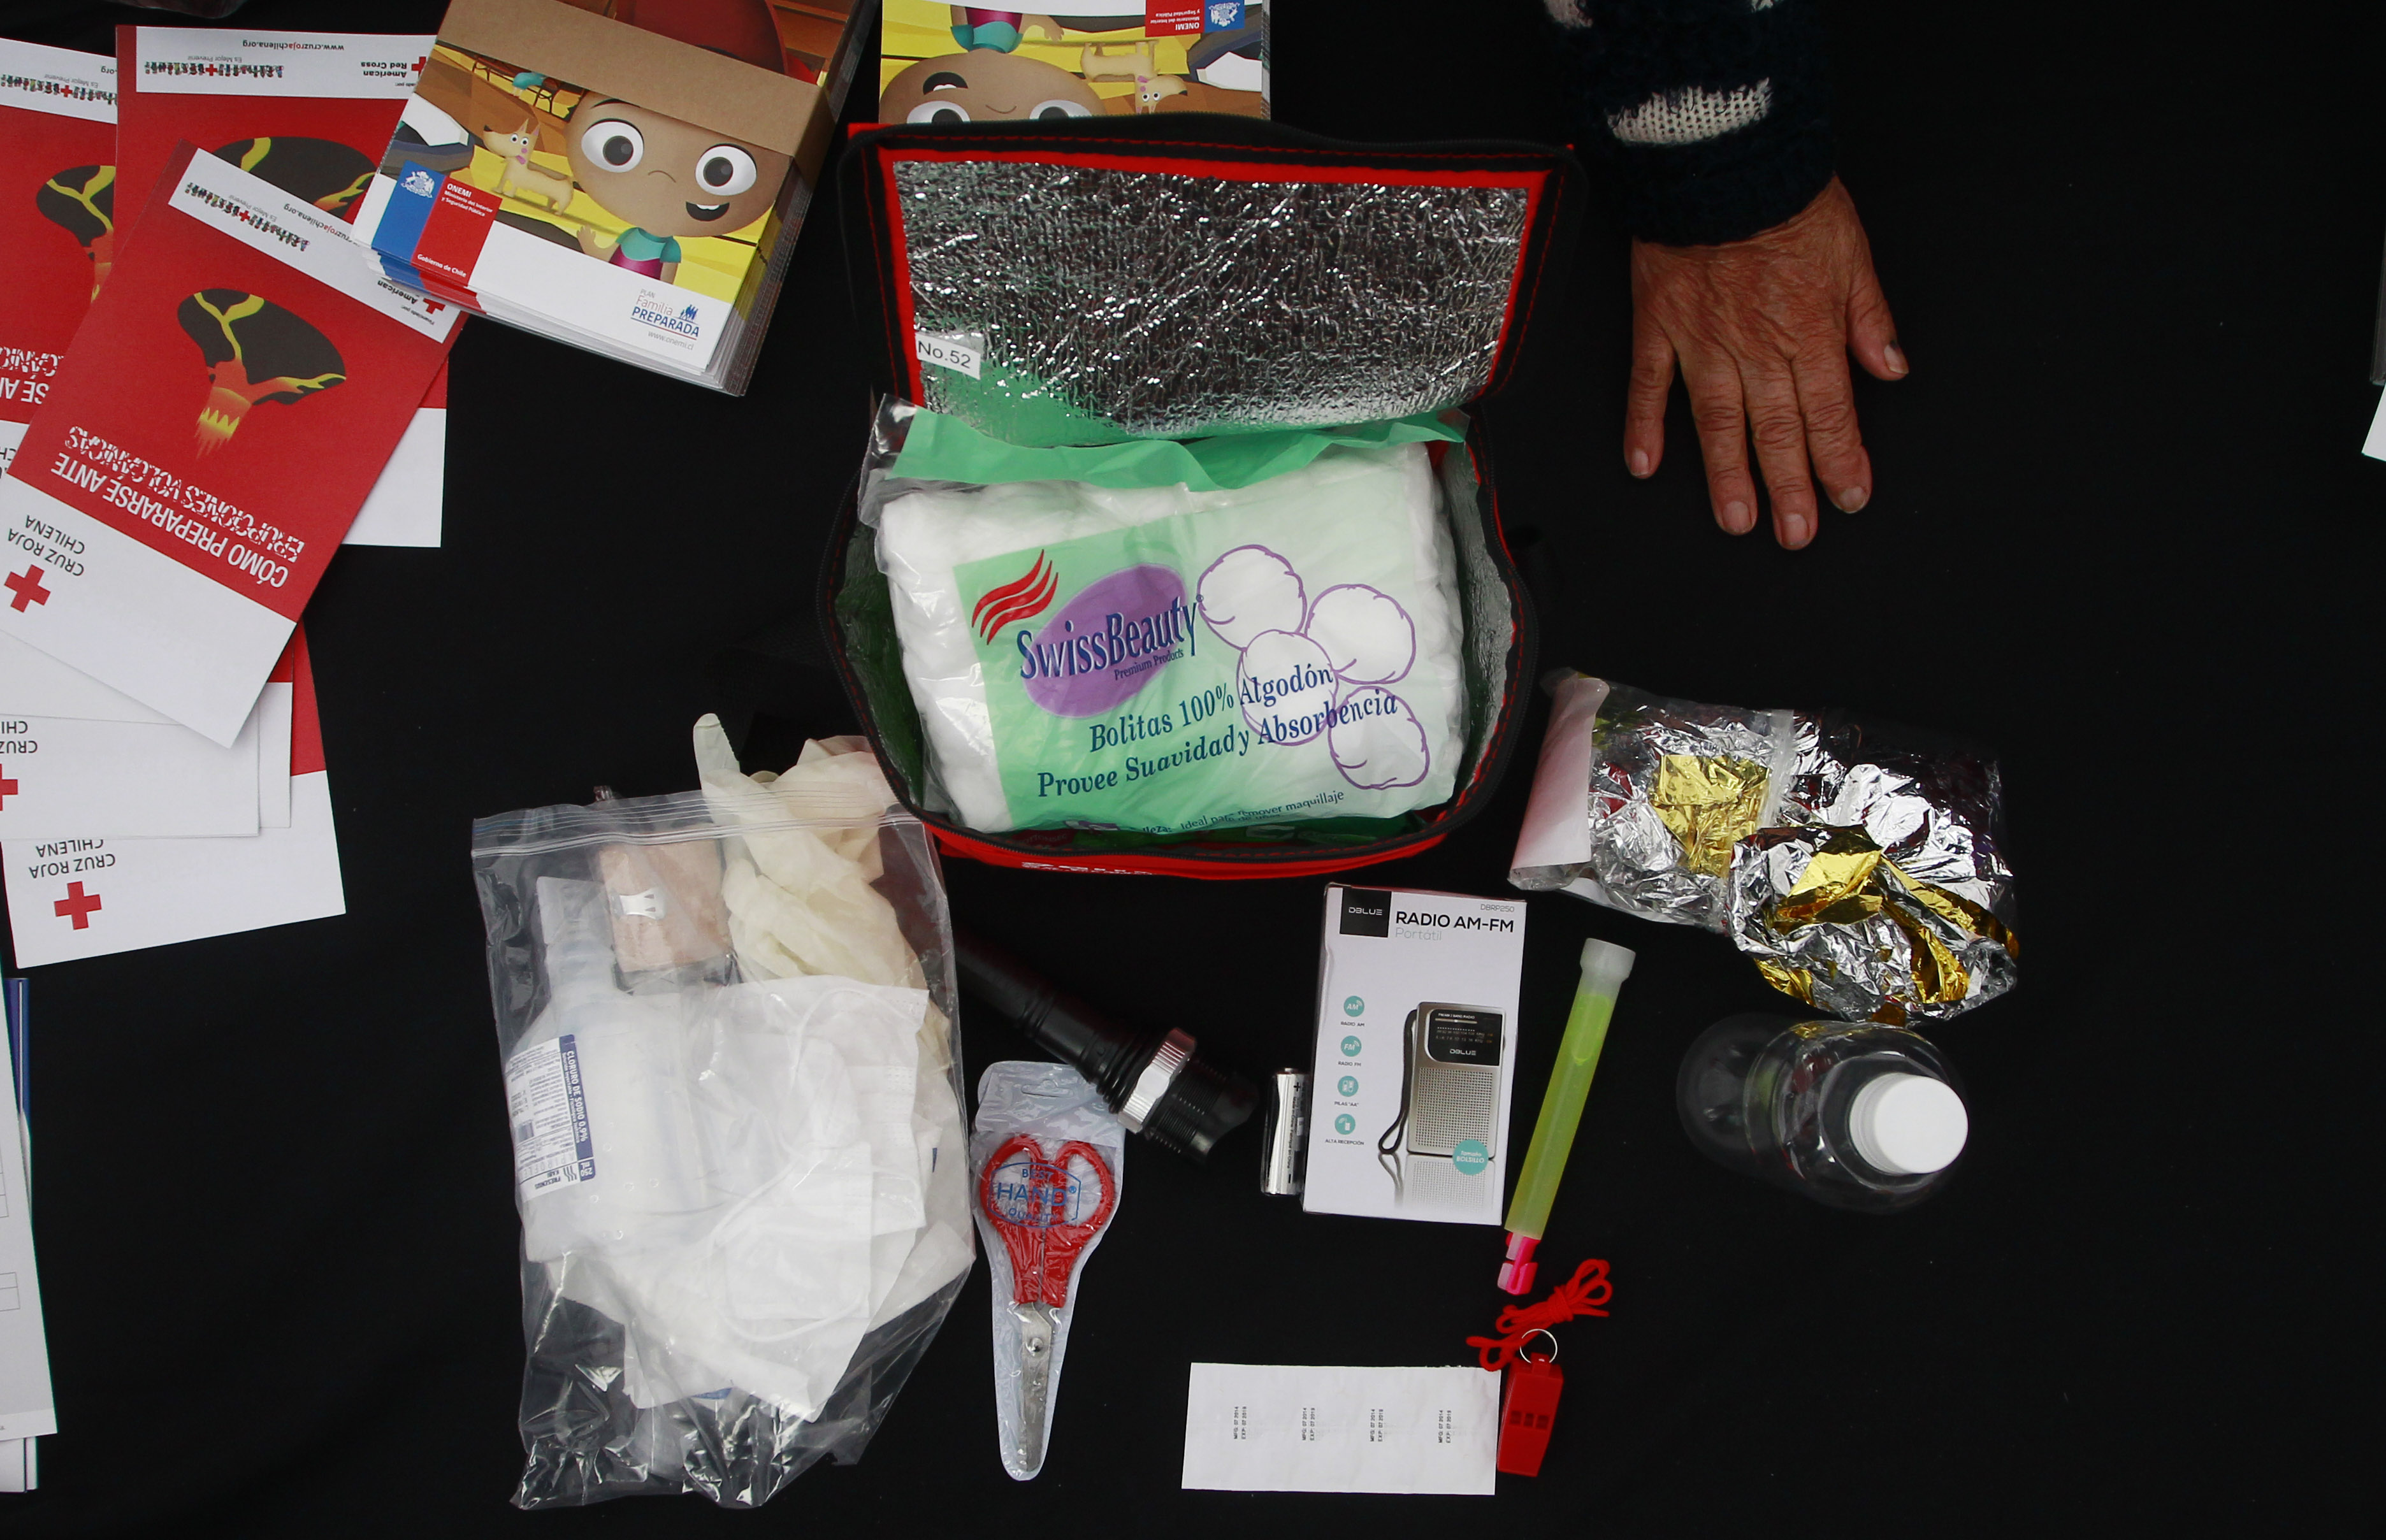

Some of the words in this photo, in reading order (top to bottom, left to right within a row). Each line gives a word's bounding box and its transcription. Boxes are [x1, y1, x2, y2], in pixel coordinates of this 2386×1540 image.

[1175, 22, 1200, 31] ONEMI
[242, 39, 344, 50] www.cruzrojachilena.org
[360, 61, 387, 69] Cross
[363, 70, 407, 78] American
[389, 62, 407, 70] Red
[447, 183, 472, 198] ONEMI
[417, 254, 444, 269] Gobierno
[451, 267, 466, 278] Chile
[377, 280, 419, 305] American
[640, 288, 656, 299] PLAN
[635, 294, 674, 316] Familia
[632, 306, 700, 338] PREPARADA
[647, 331, 695, 351] www.onemi.cl
[918, 340, 971, 370] No.52
[50, 452, 108, 493] ANTE
[64, 426, 182, 503] VOLCÁNICAS
[102, 479, 229, 558] PREPARARSE
[180, 485, 305, 563] ERUPCIONES
[7, 528, 45, 557] ROJA
[25, 514, 85, 555] CHILENA
[44, 548, 85, 577] CRUZ
[228, 543, 289, 588] CÓMO
[1113, 660, 1155, 681] Premium
[1153, 647, 1185, 666] Products
[1088, 714, 1173, 753] Bolitas
[1178, 682, 1234, 728] 100%
[1239, 663, 1334, 708] Algodón
[1037, 760, 1118, 797] Provee
[1257, 689, 1399, 745] Absorbencia
[1179, 815, 1210, 832] Ideal
[1285, 790, 1344, 816] maquillaje
[36, 839, 105, 858] CHILENA
[29, 862, 69, 879] ROJA
[74, 854, 115, 872] CRUZ
[1396, 911, 1450, 927] RADIO
[1454, 916, 1515, 933] AM-FM
[1395, 927, 1442, 941] Portátil
[1347, 1002, 1359, 1011] AM
[567, 1051, 579, 1086] CLORURO
[572, 1086, 581, 1097] DE
[574, 1097, 585, 1121] SODIO
[1456, 1155, 1485, 1163] BOLSILLO
[580, 1167, 593, 1177] 250
[1022, 1168, 1054, 1180] BEST
[996, 1182, 1068, 1206] HAND
[1008, 1207, 1057, 1223] QUALITY
